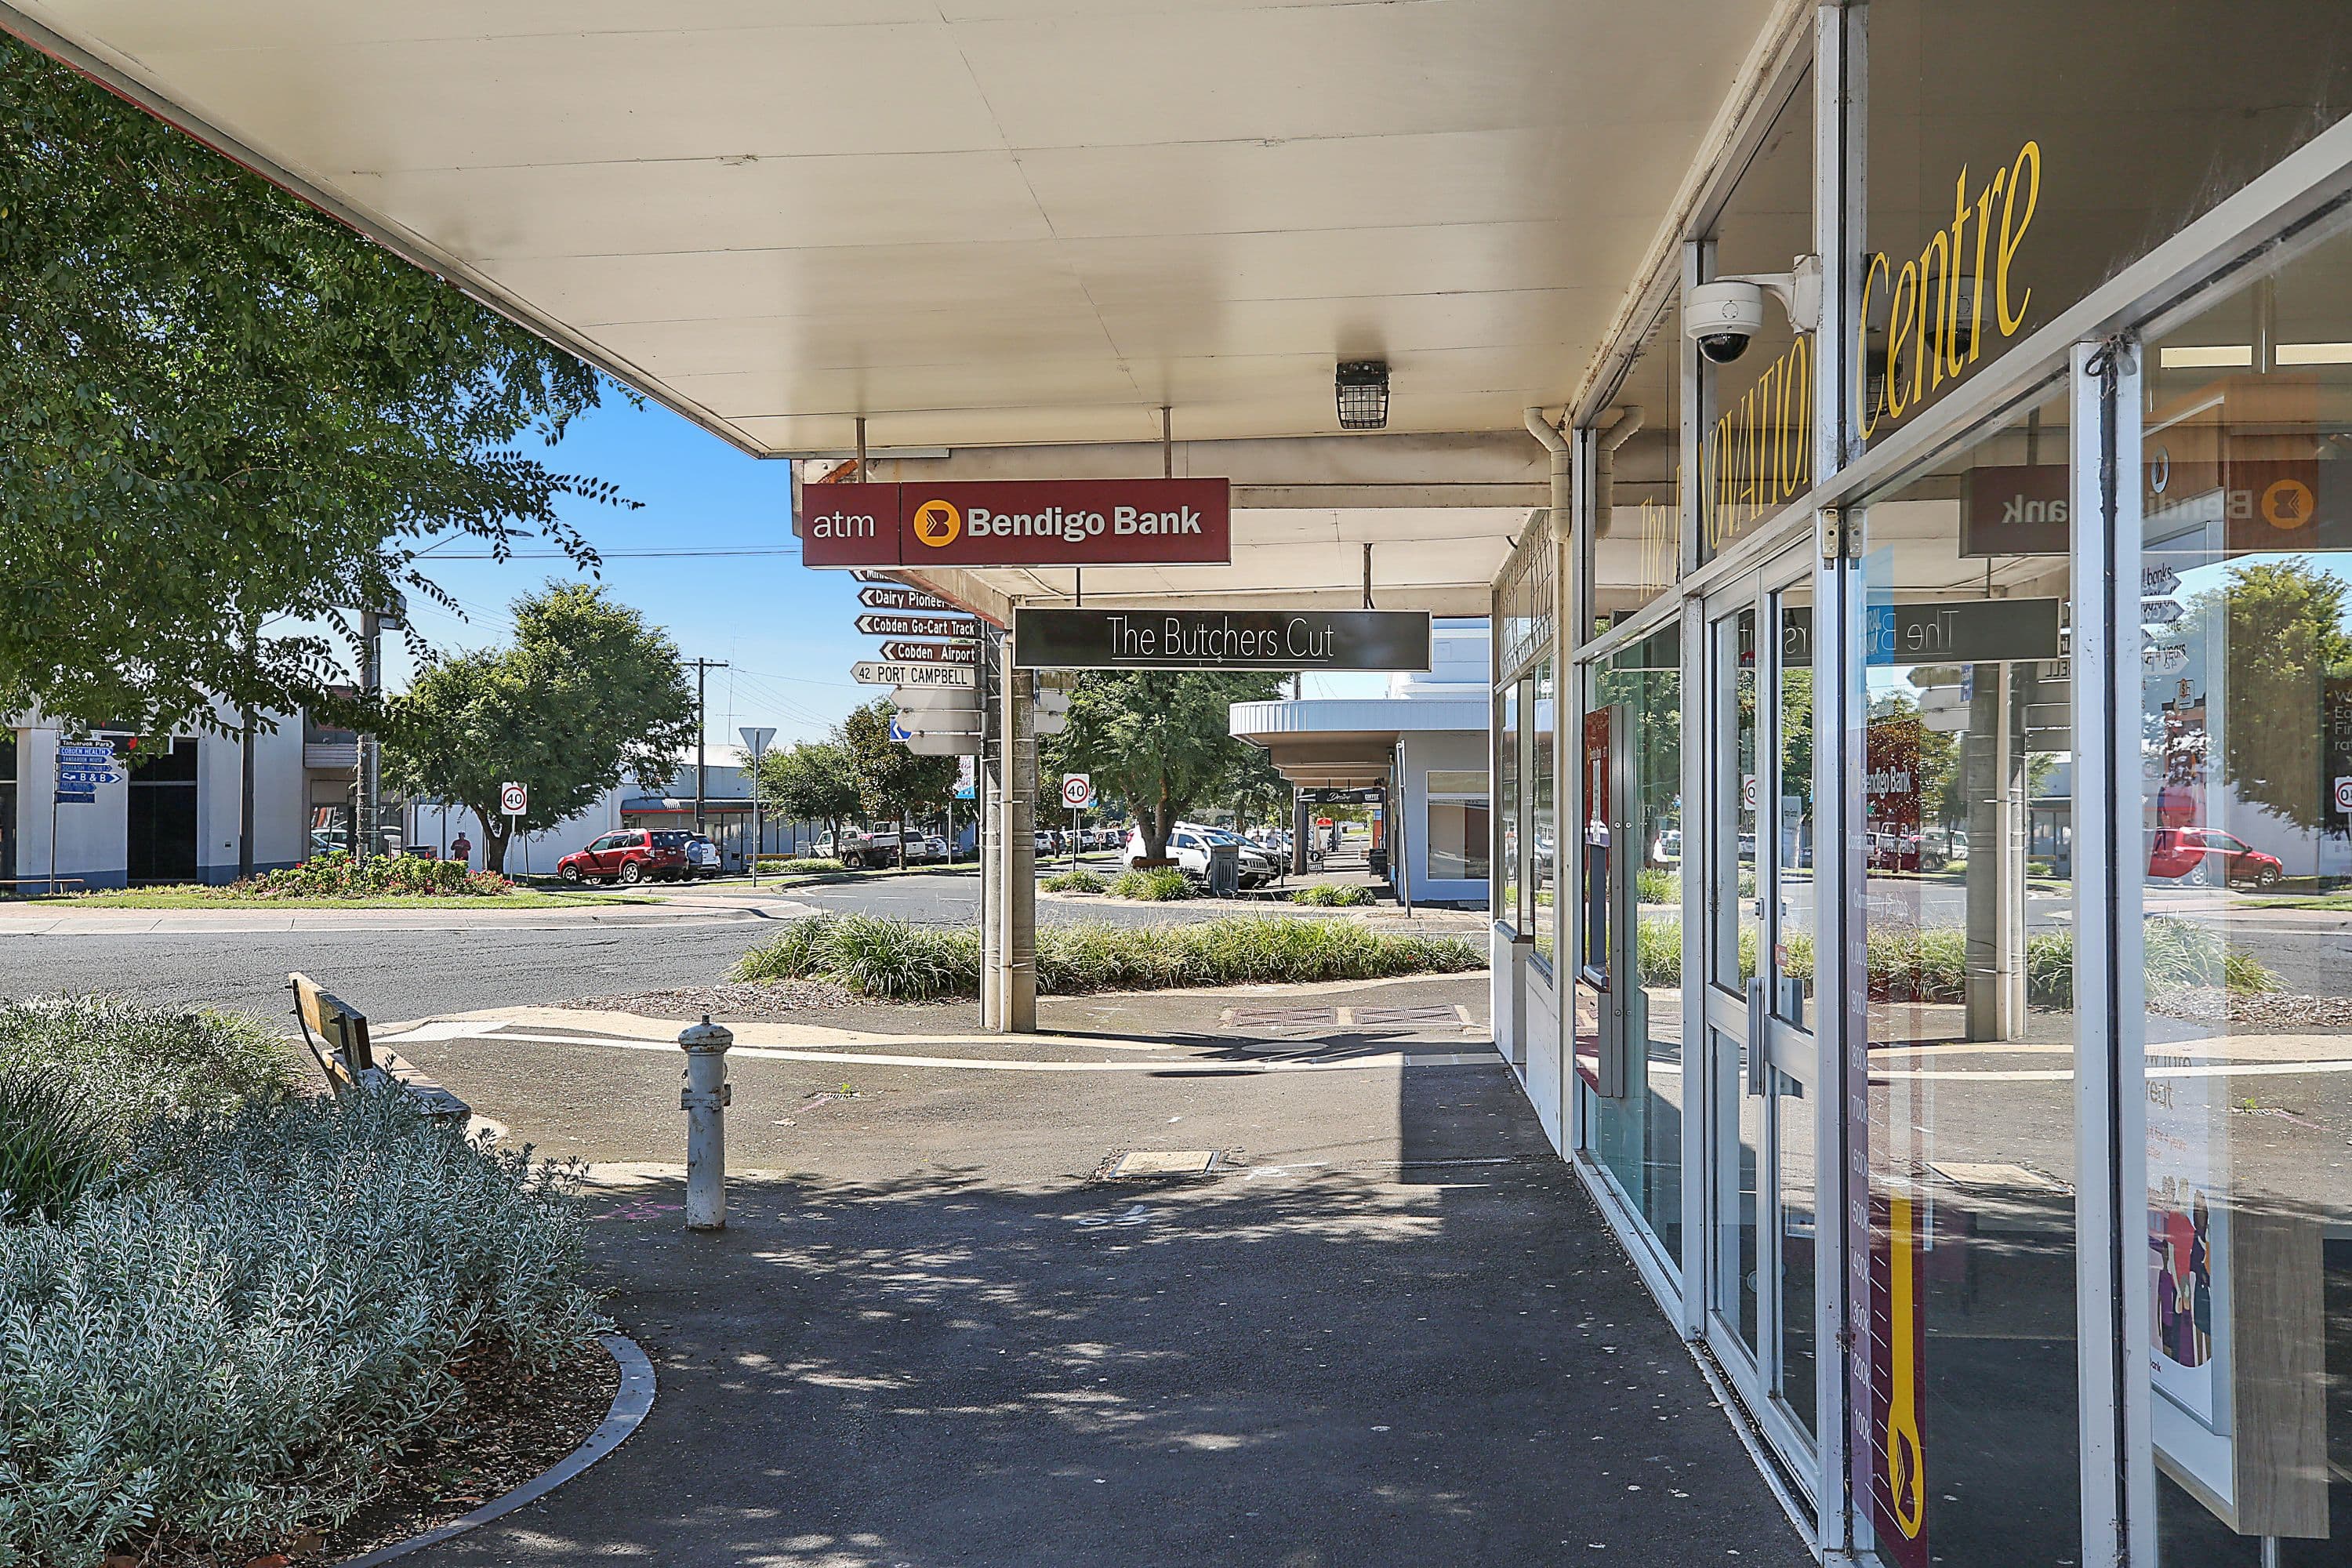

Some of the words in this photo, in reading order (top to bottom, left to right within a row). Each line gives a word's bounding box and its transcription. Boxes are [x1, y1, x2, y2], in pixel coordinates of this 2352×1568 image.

[1857, 141, 2040, 440] Centre
[812, 510, 875, 538] atm
[967, 506, 1105, 543] Bendigo
[1114, 506, 1202, 534] Bank
[876, 590, 904, 608] Dairy
[873, 618, 908, 633] Cobden
[912, 619, 948, 634] Go-Cart
[952, 621, 975, 635] Track
[1107, 615, 1156, 655] The
[1165, 615, 1278, 656] Butchers
[1287, 618, 1334, 656] Cut
[898, 644, 933, 659] Cobden
[941, 646, 975, 662] Airport
[858, 667, 871, 680] 42
[877, 666, 906, 682] PORT
[911, 668, 967, 684] CAMPBELL
[1890, 765, 1911, 793] Bank
[506, 793, 522, 804] 40
[1068, 786, 1084, 797] 40
